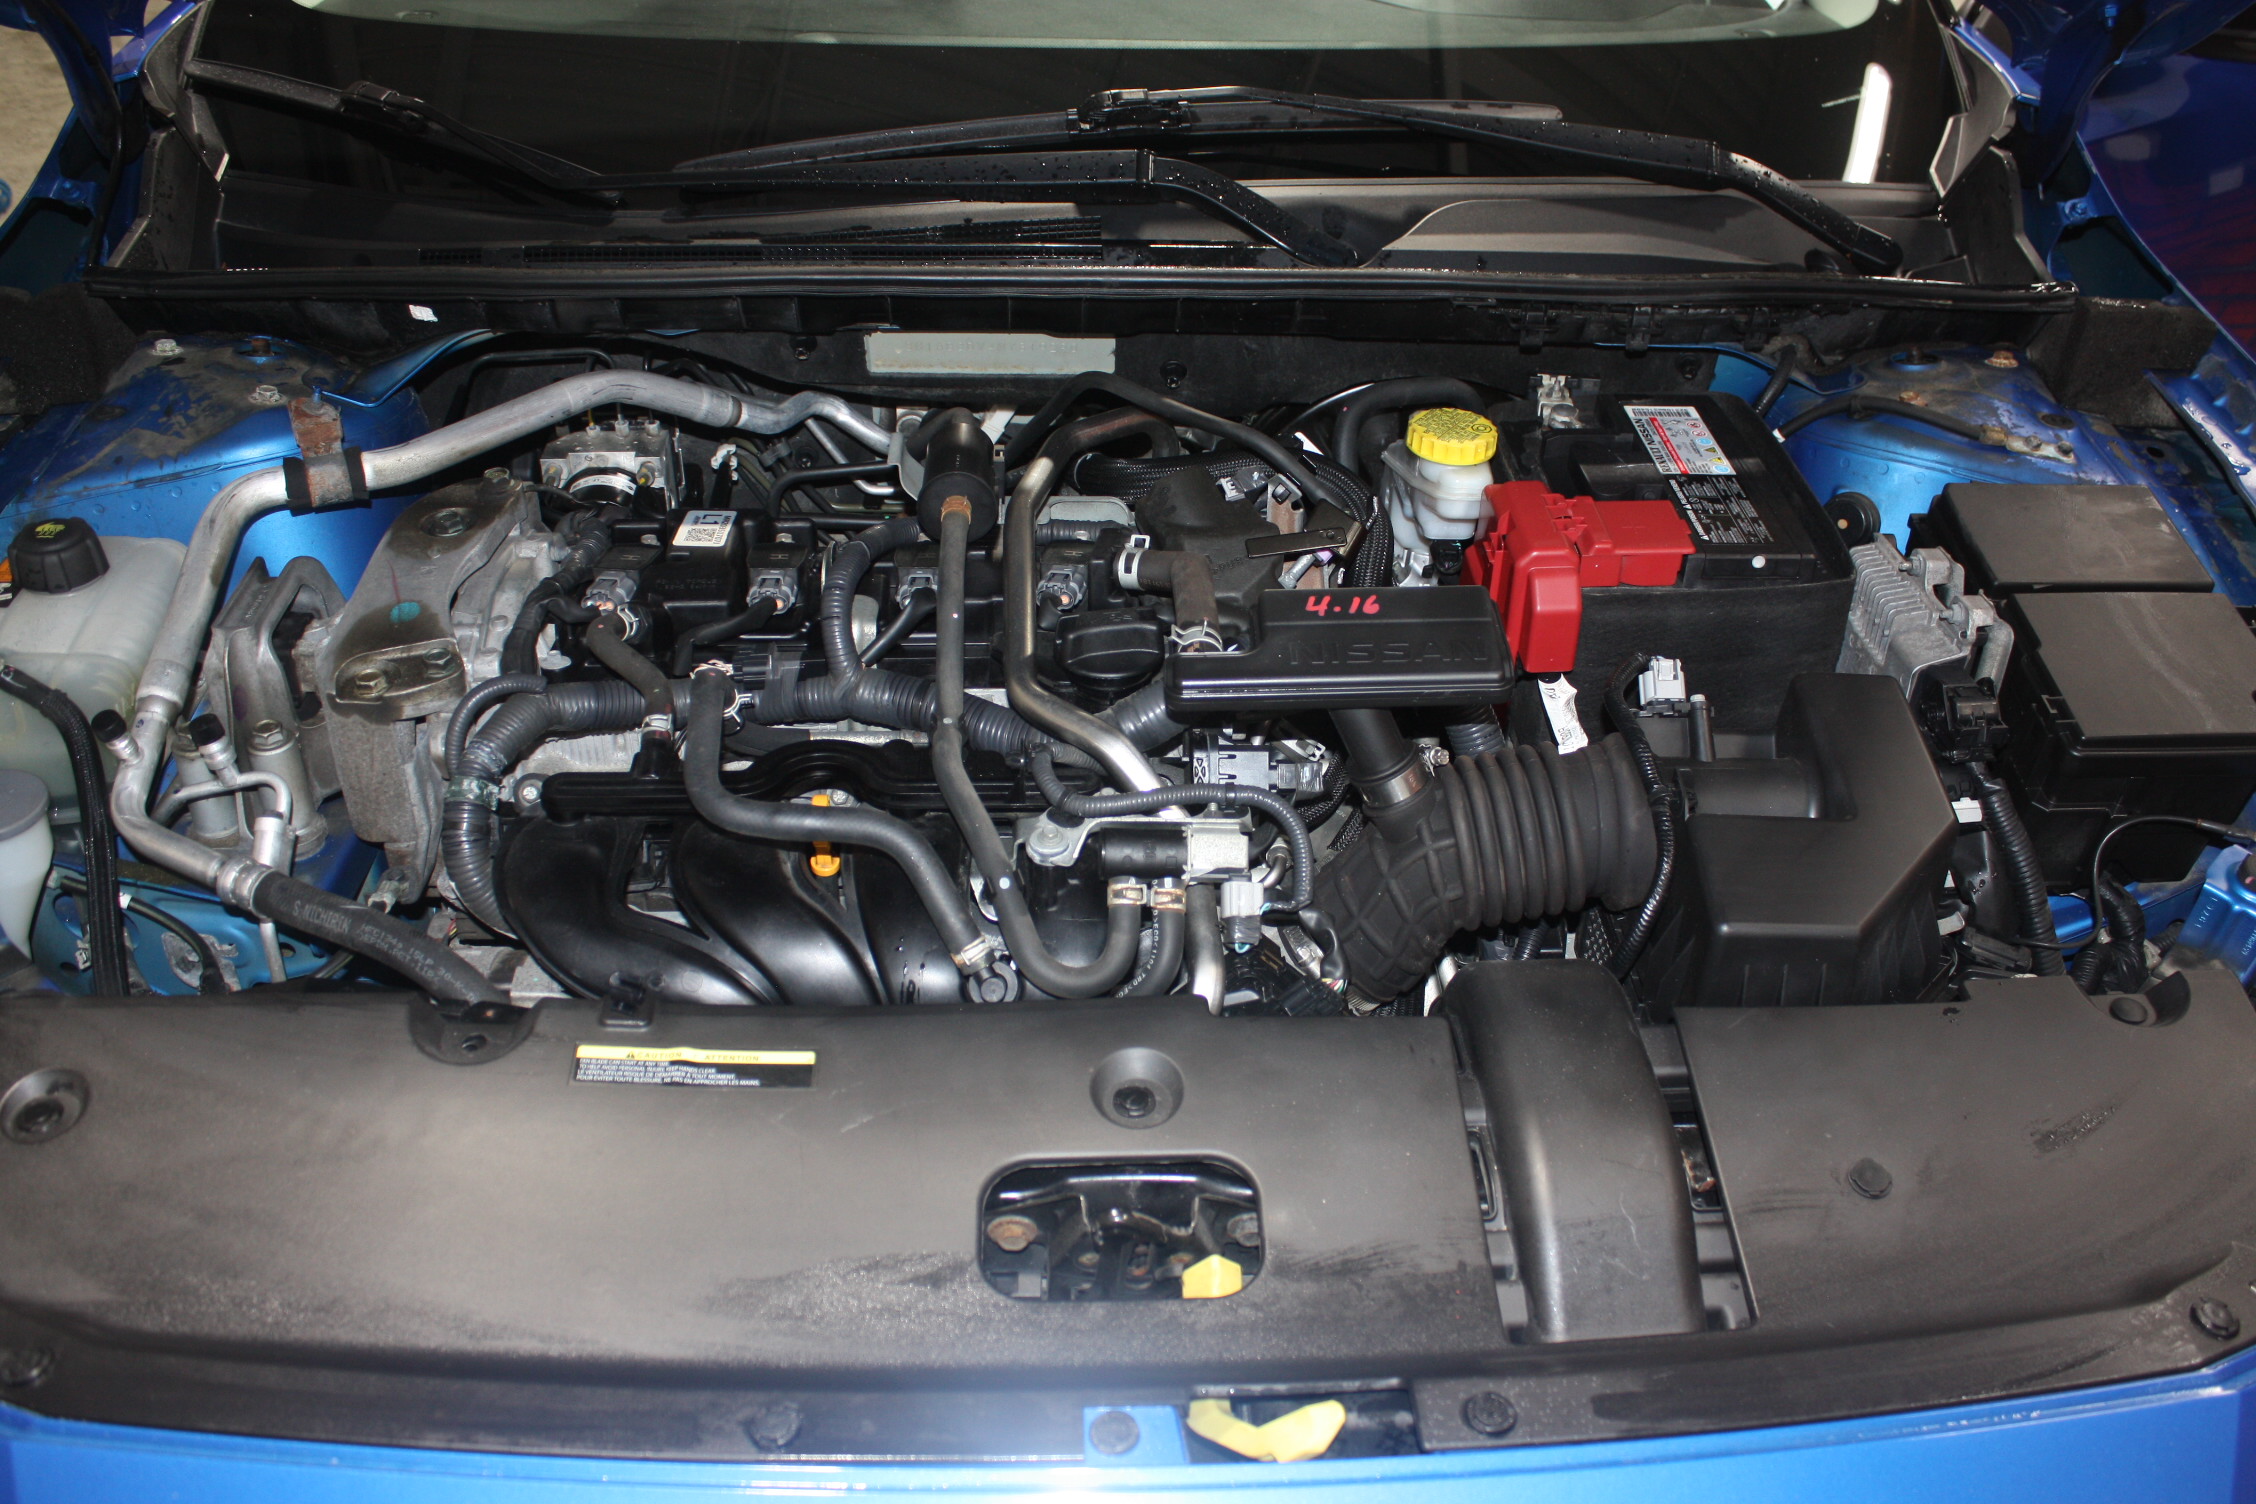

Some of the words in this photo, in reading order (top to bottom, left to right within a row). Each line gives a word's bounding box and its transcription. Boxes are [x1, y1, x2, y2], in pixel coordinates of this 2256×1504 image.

[1632, 418, 1656, 447] NISSAN
[1305, 595, 1380, 616] 4.16
[1291, 642, 1488, 665] NISSAN
[637, 1052, 682, 1060] CAUTION
